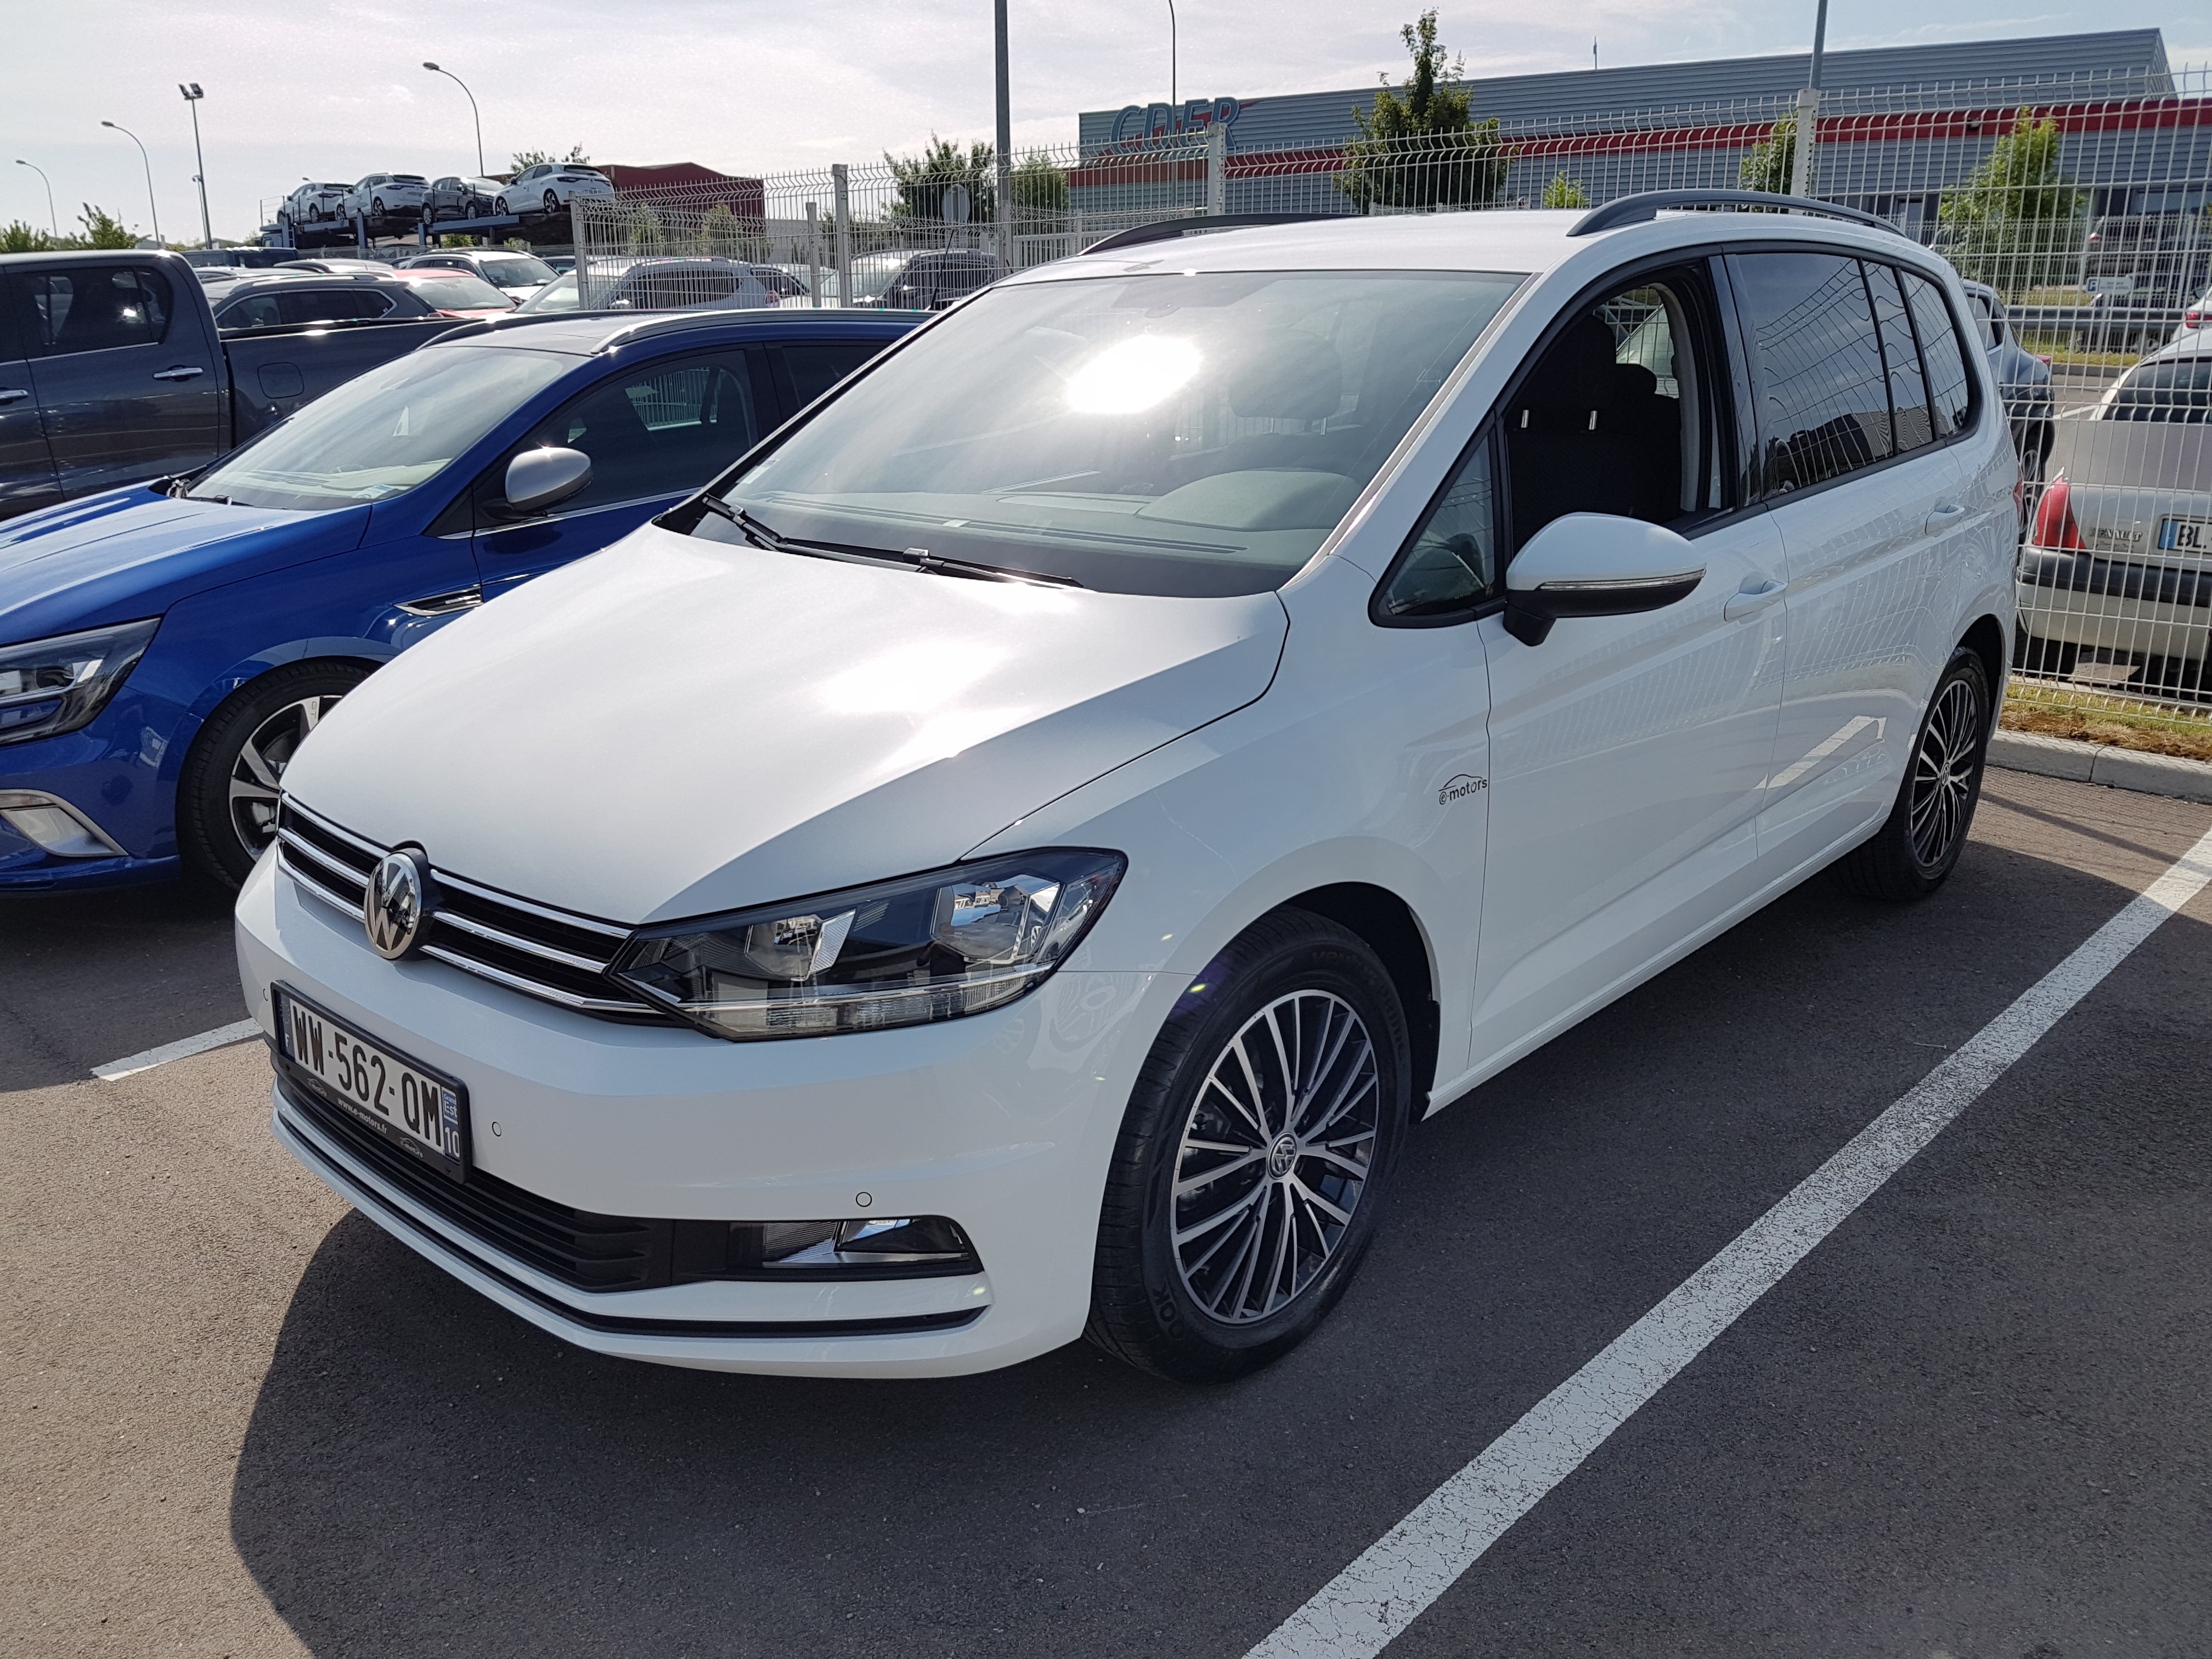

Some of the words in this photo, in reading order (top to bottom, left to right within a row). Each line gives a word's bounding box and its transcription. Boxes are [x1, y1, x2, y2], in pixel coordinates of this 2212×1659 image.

[1111, 97, 1239, 155] CDER
[2177, 524, 2208, 549] BL
[293, 1005, 441, 1148] WW-562-QM
[337, 1098, 387, 1134] www.e-motors.fr
[444, 1126, 460, 1158] 10
